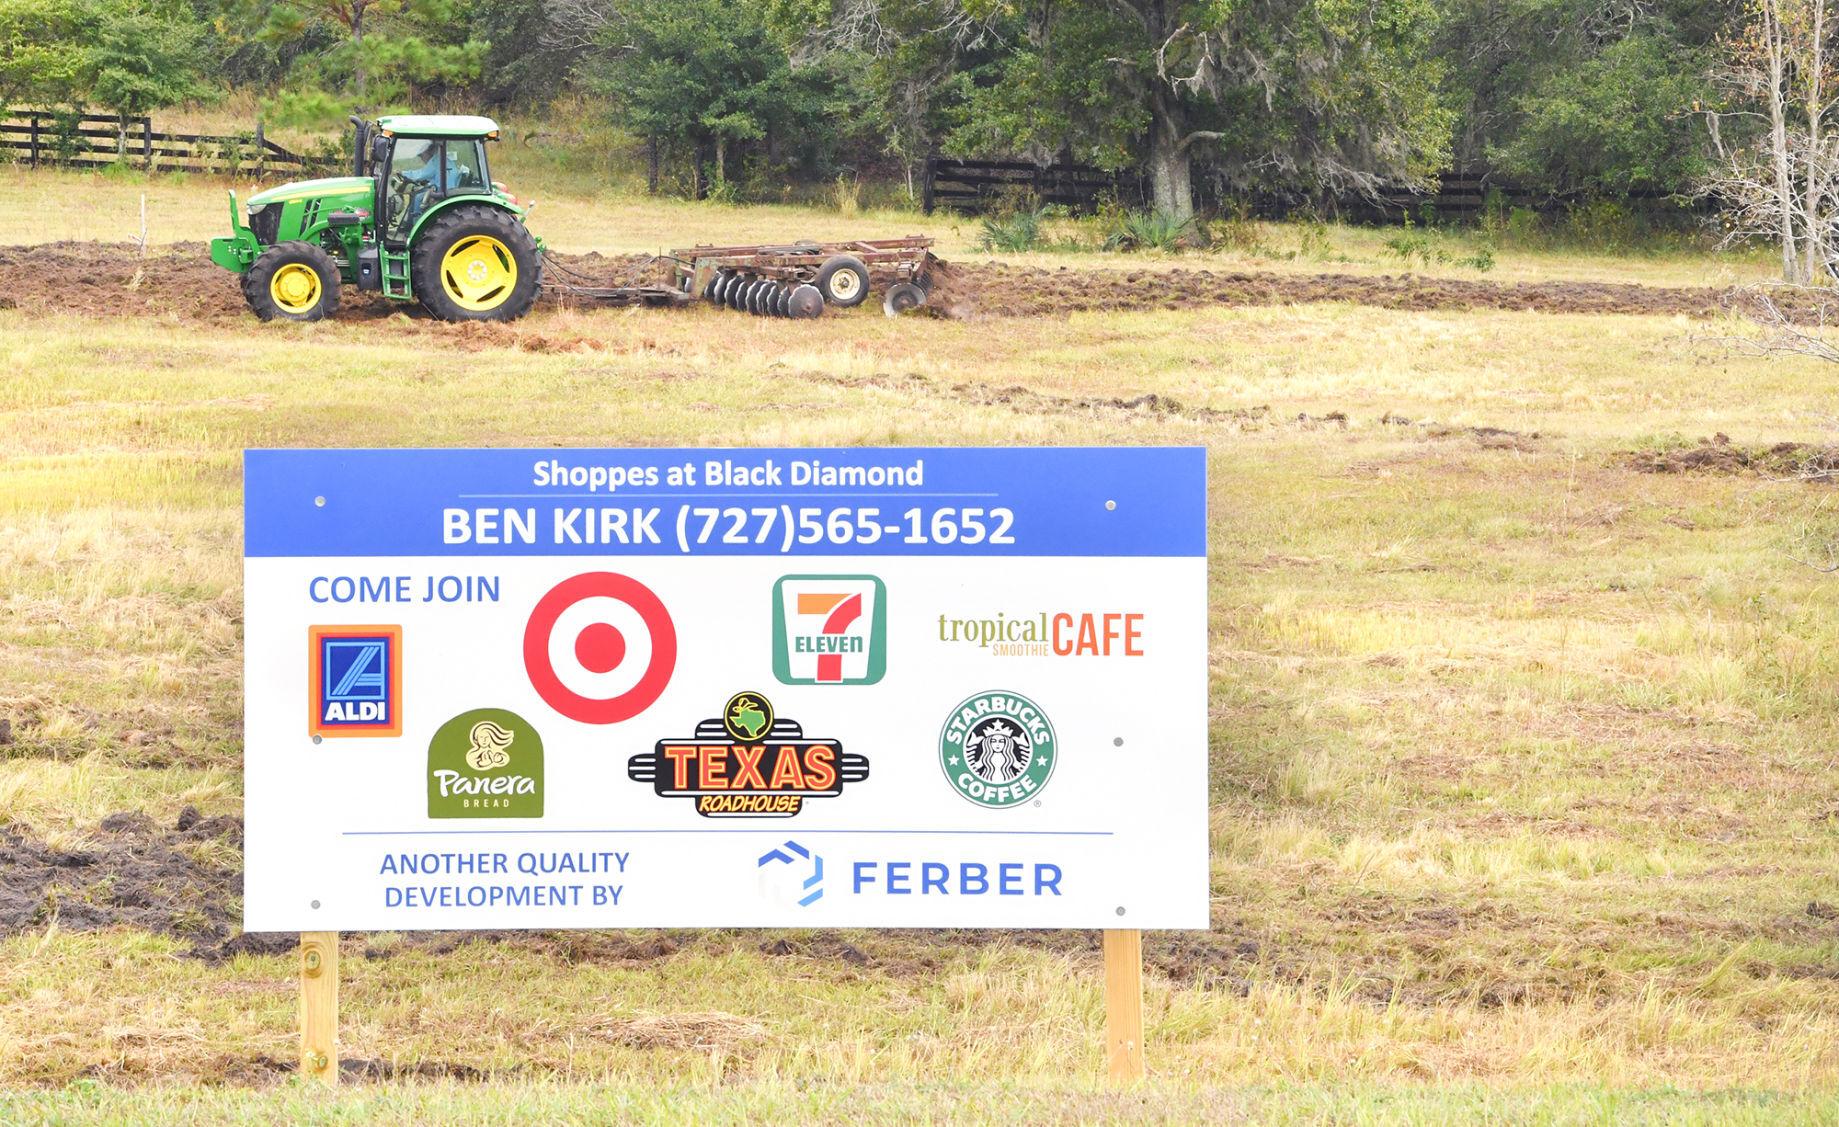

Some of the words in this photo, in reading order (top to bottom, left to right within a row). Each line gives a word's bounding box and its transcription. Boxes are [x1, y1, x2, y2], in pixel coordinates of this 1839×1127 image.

[533, 460, 659, 491] Shoppes
[666, 463, 697, 486] at
[704, 460, 782, 486] Black
[790, 460, 924, 487] Diamond
[442, 508, 536, 545] BEN
[554, 508, 661, 544] KIRK
[676, 504, 1015, 553] (727)565-1652
[308, 576, 412, 603] COME
[422, 575, 500, 603] JOIN
[797, 592, 862, 682] 7
[938, 613, 1048, 648] tropical
[1052, 613, 1144, 656] CAFE
[992, 643, 1049, 657] SMOOTHIE
[325, 702, 386, 721] ALDI
[946, 696, 1051, 746] STARBUCKS
[664, 745, 837, 790] TEXAS
[433, 769, 535, 797] Panera
[957, 772, 1037, 803] COFFEE
[463, 799, 510, 808] BREAD
[699, 795, 800, 813] ROADHOUSE
[380, 853, 508, 875] ANOTHER
[517, 852, 630, 876] QUALITY
[853, 862, 1063, 896] FERBER
[385, 885, 584, 908] DEVELOPMENT
[592, 885, 624, 907] BY
